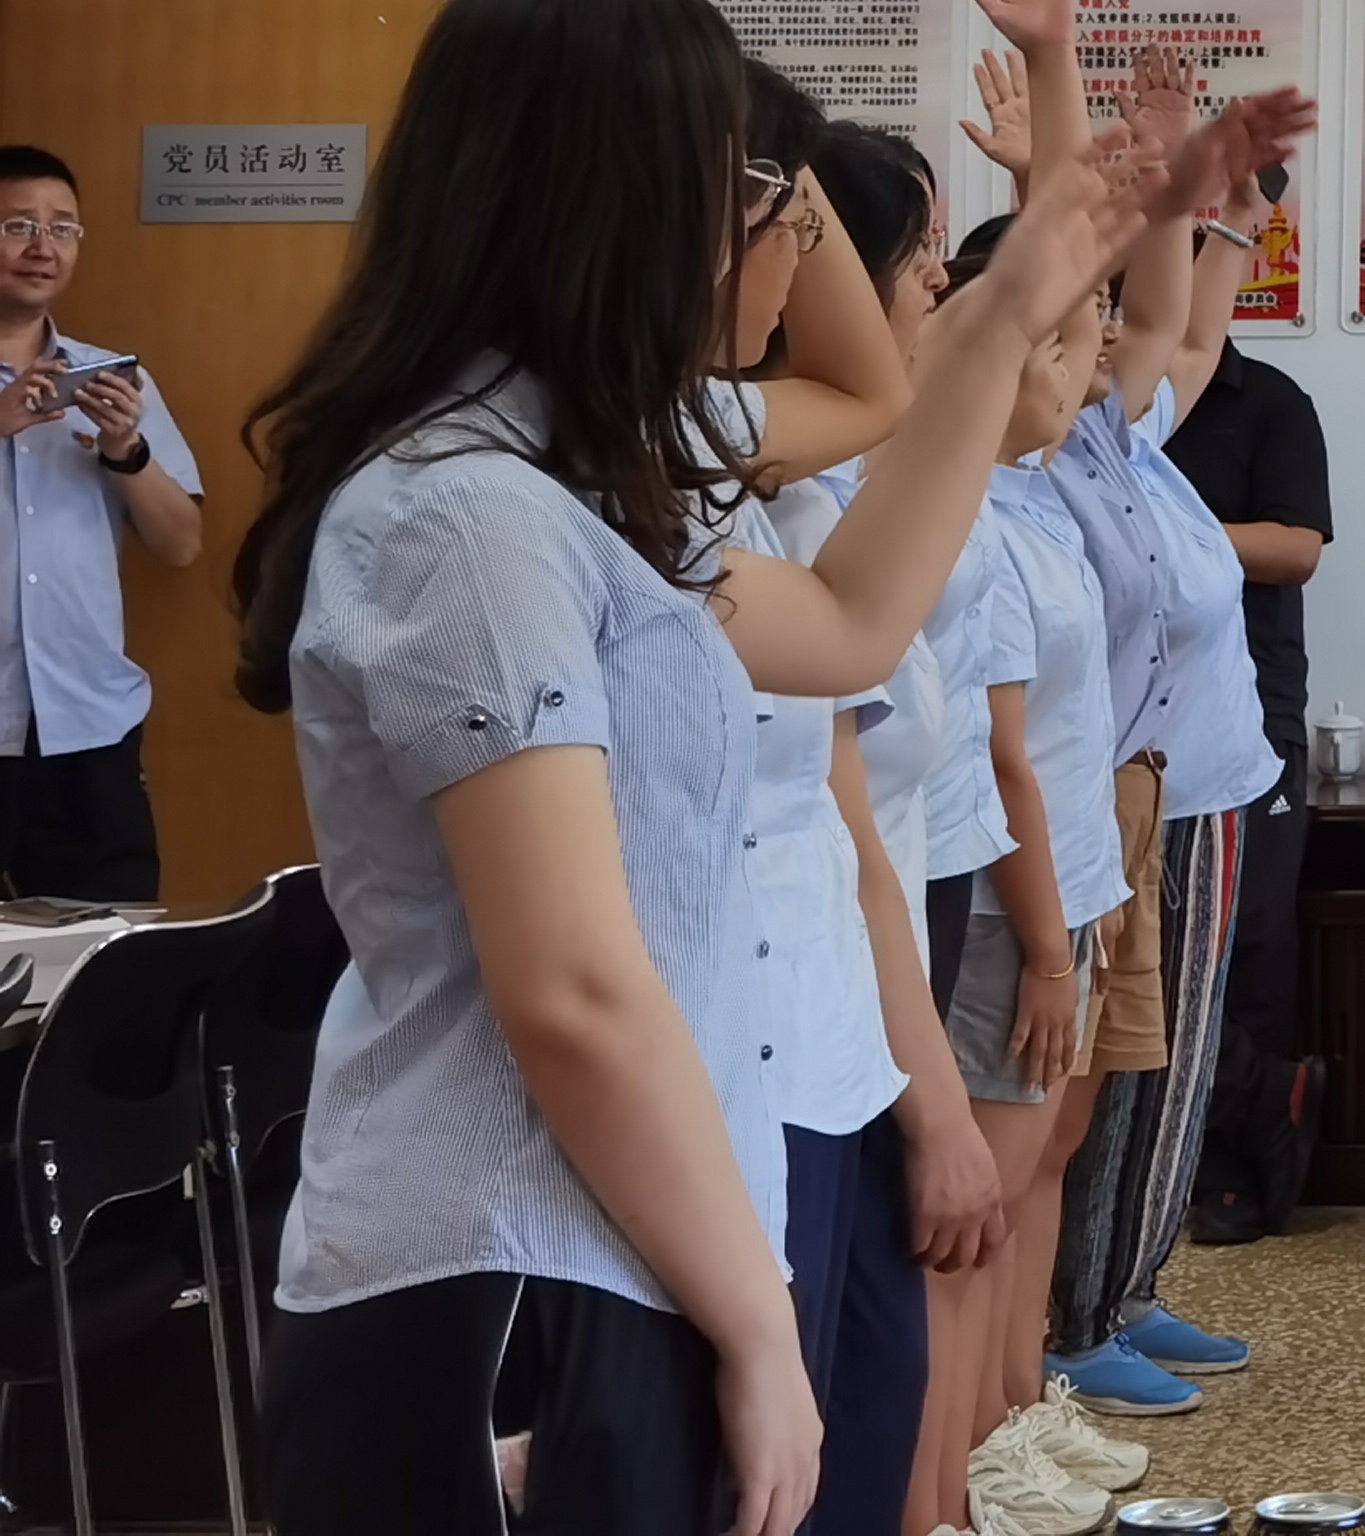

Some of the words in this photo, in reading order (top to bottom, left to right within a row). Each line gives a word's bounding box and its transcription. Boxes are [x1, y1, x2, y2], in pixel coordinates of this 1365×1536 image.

[162, 143, 346, 174] 党员活动室
[157, 193, 187, 207] CPC
[195, 193, 247, 207] member
[250, 192, 307, 206] activities
[310, 194, 344, 206] room
